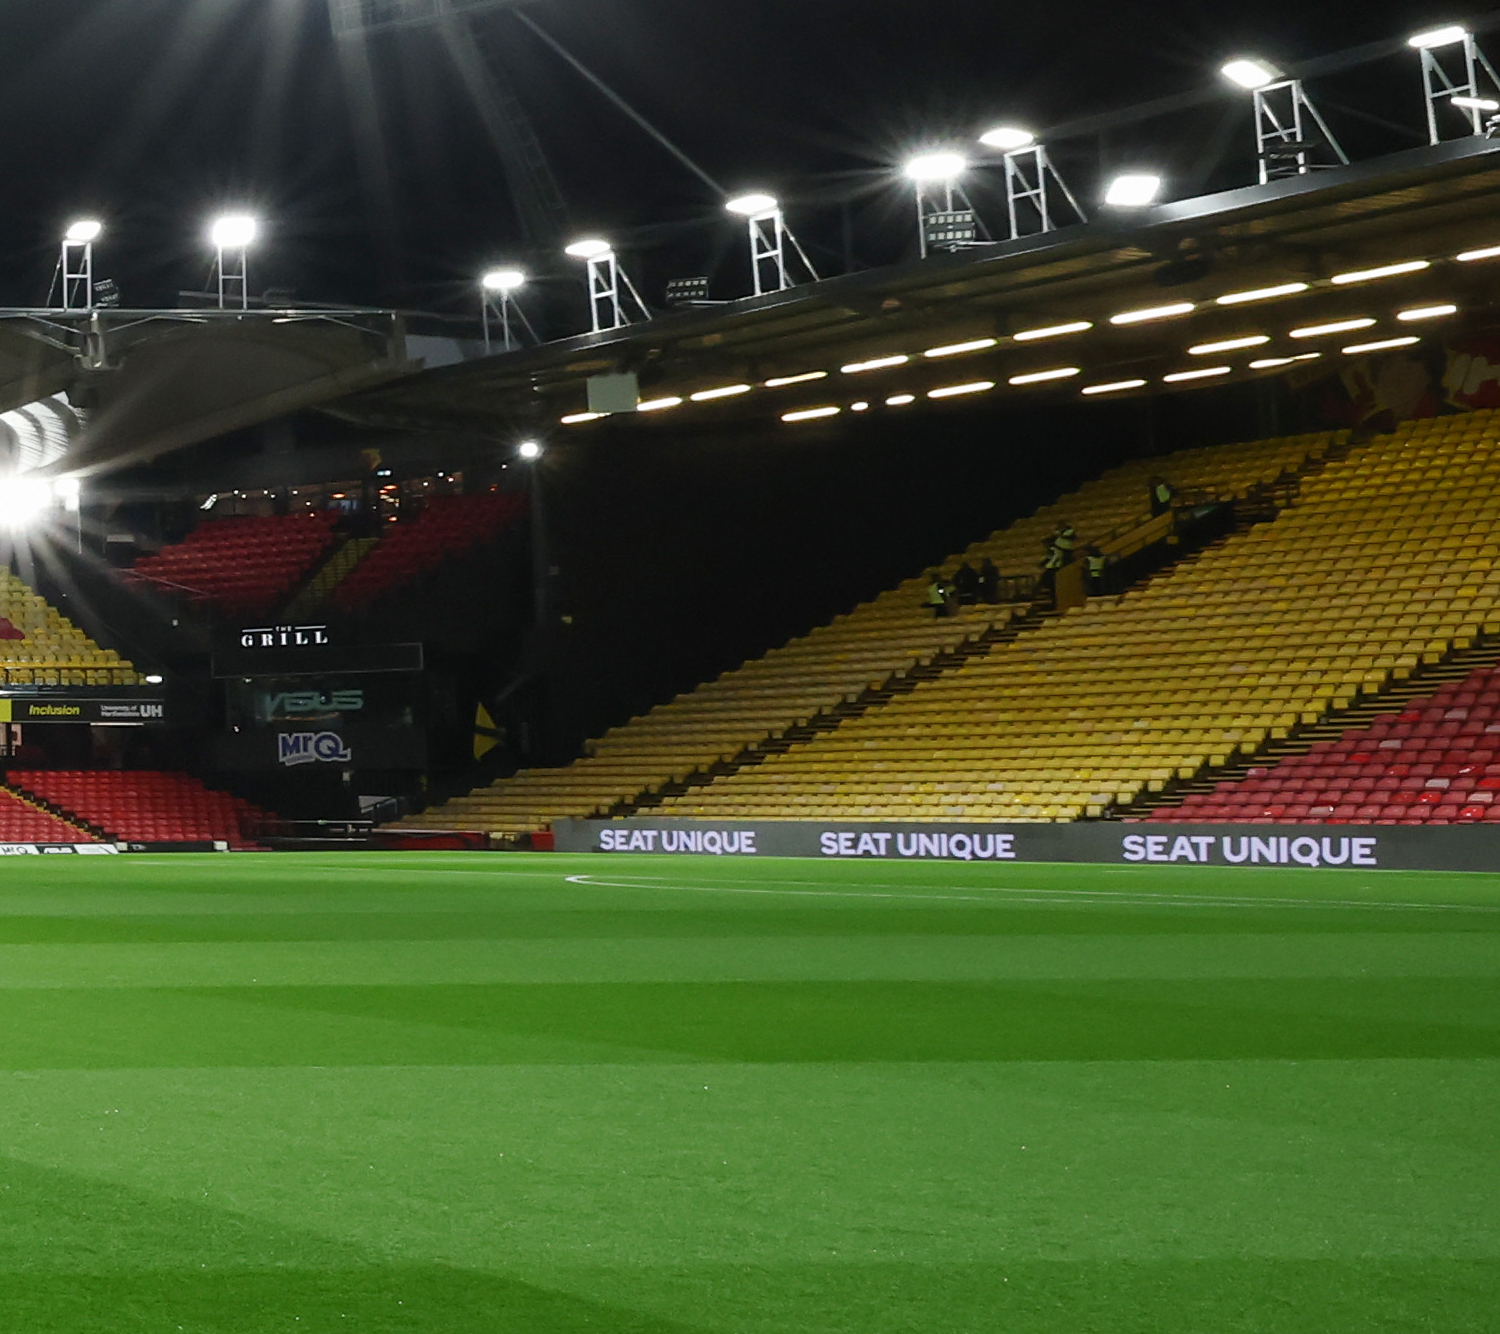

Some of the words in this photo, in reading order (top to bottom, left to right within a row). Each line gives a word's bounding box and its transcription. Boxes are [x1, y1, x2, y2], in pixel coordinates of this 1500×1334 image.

[241, 631, 328, 647] GRILL
[29, 705, 80, 716] Inclusion
[140, 705, 163, 717] UH
[600, 829, 658, 851] SEAT
[662, 831, 757, 854] UNIQUE
[820, 832, 892, 855] SEAT
[897, 833, 1016, 860] UNIQUE
[1123, 835, 1216, 862] SEAT
[1222, 836, 1377, 867] UNIQUE
